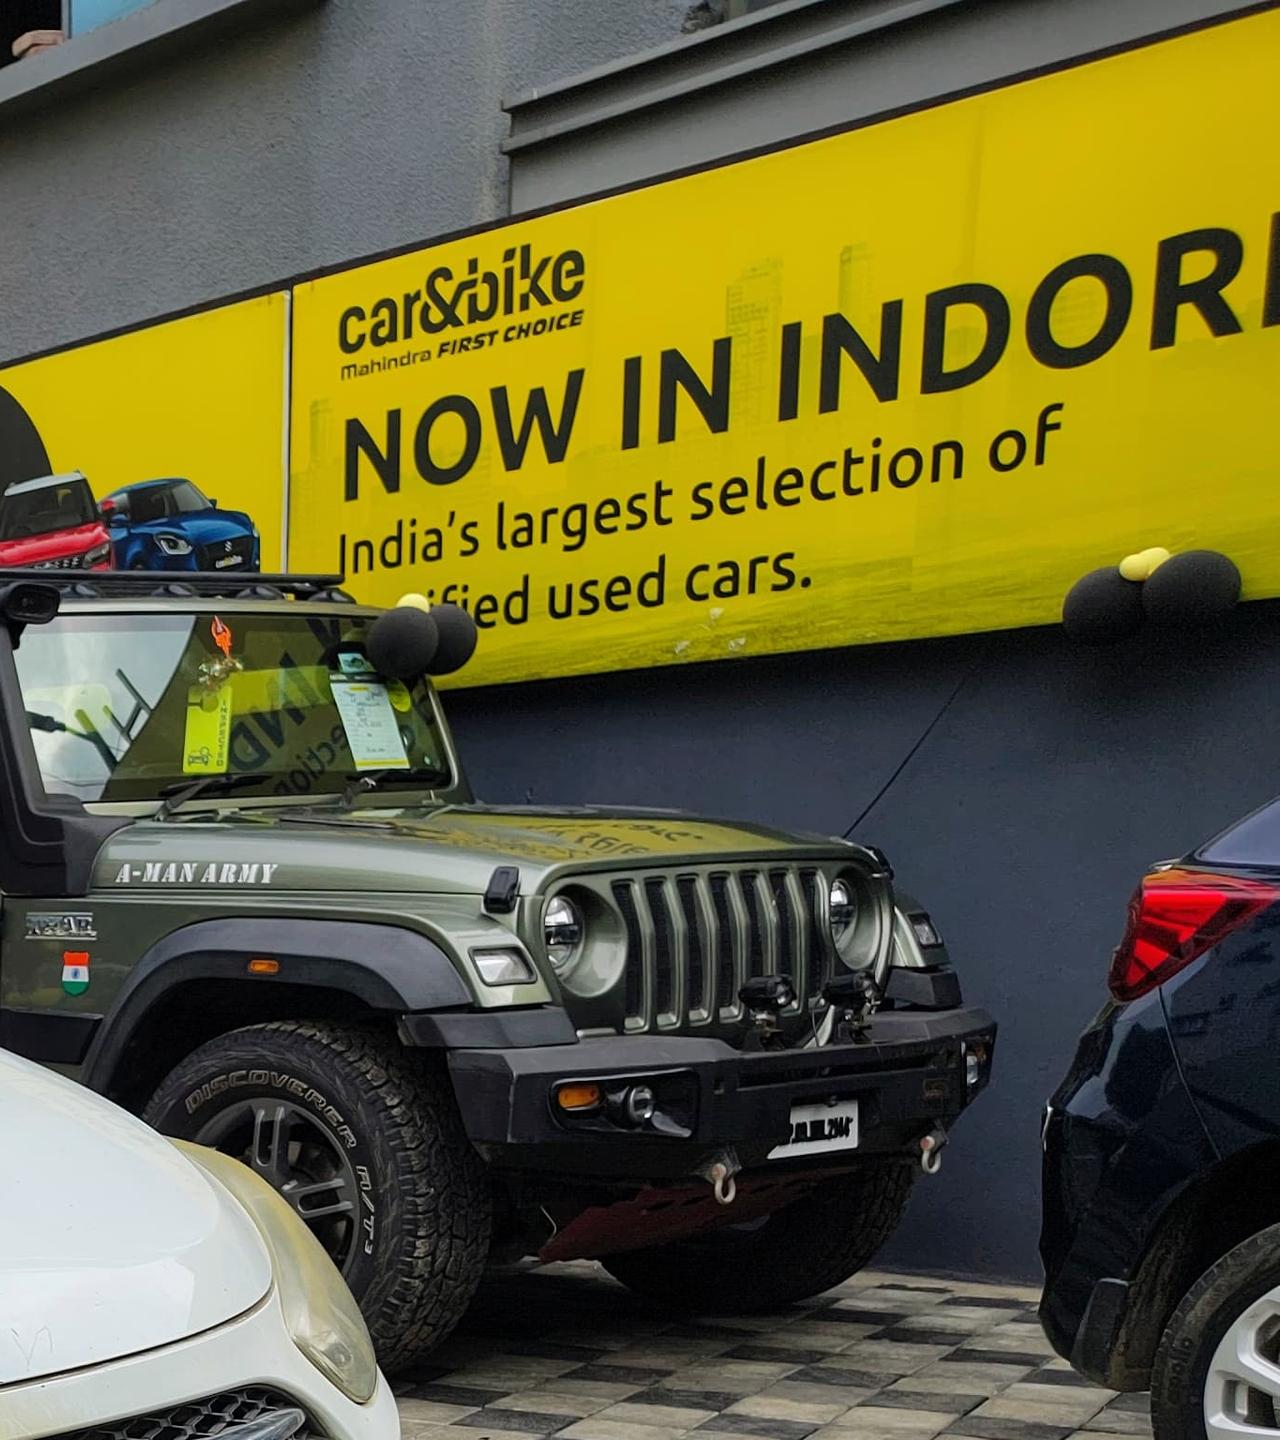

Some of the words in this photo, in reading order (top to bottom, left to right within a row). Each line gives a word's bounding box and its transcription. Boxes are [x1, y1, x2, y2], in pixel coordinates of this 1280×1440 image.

[338, 244, 585, 354] car&bike
[340, 350, 431, 381] Mahindra
[438, 330, 498, 357] FIRST
[503, 309, 584, 342] CHOICE
[344, 369, 586, 502] NOW
[621, 336, 732, 450] IN
[339, 510, 480, 575] India's
[496, 481, 673, 552] largest
[690, 437, 964, 521] selection
[989, 403, 1064, 473] of
[548, 554, 666, 619] used
[685, 551, 812, 602] cars.
[115, 863, 197, 883] A-MAN
[200, 864, 277, 884] ARMY
[185, 1070, 357, 1149] DISCOVERER
